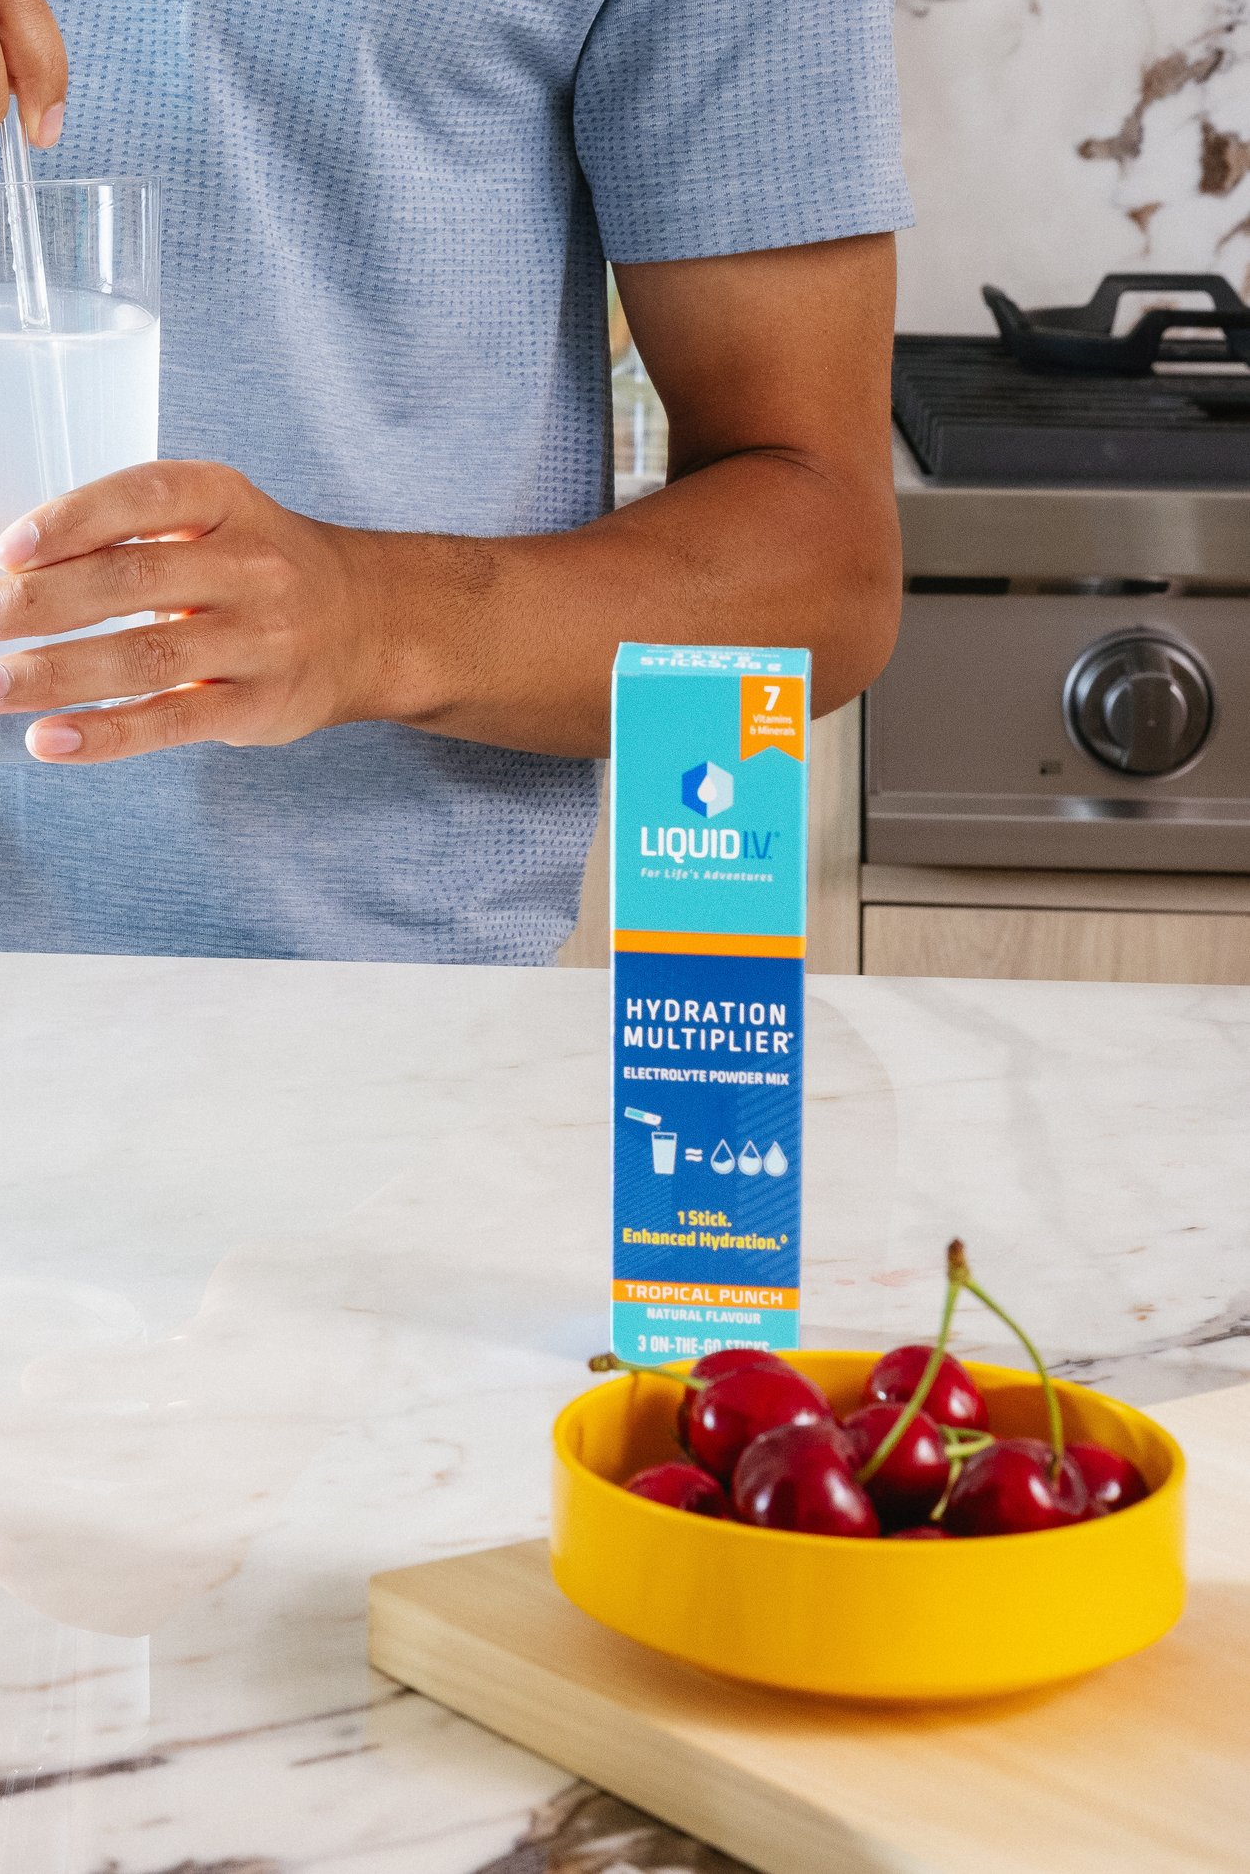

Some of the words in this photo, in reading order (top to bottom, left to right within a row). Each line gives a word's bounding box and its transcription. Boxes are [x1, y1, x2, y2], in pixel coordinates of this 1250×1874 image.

[763, 685, 781, 712] 7
[752, 714, 793, 725] Vitamins
[757, 726, 796, 737] Minerals
[640, 826, 741, 864] LIQUID
[640, 867, 661, 879] For
[664, 867, 699, 881] Life's
[703, 870, 773, 883] Adventures
[626, 997, 786, 1026] HYDRATION
[623, 1066, 707, 1083] ELECTROLYTE
[709, 1070, 764, 1085] POWDER
[765, 1073, 790, 1086] MIX
[677, 1210, 686, 1225] 1
[688, 1209, 732, 1227] Stick.
[622, 1227, 696, 1247] Enhanced
[624, 1283, 714, 1303] TROPICAL
[719, 1288, 783, 1306] PUNCH
[646, 1307, 703, 1322] NATURAL
[705, 1310, 762, 1325] FLAVOUR
[637, 1334, 647, 1352] 3
[650, 1335, 723, 1355] ON-THE-GO
